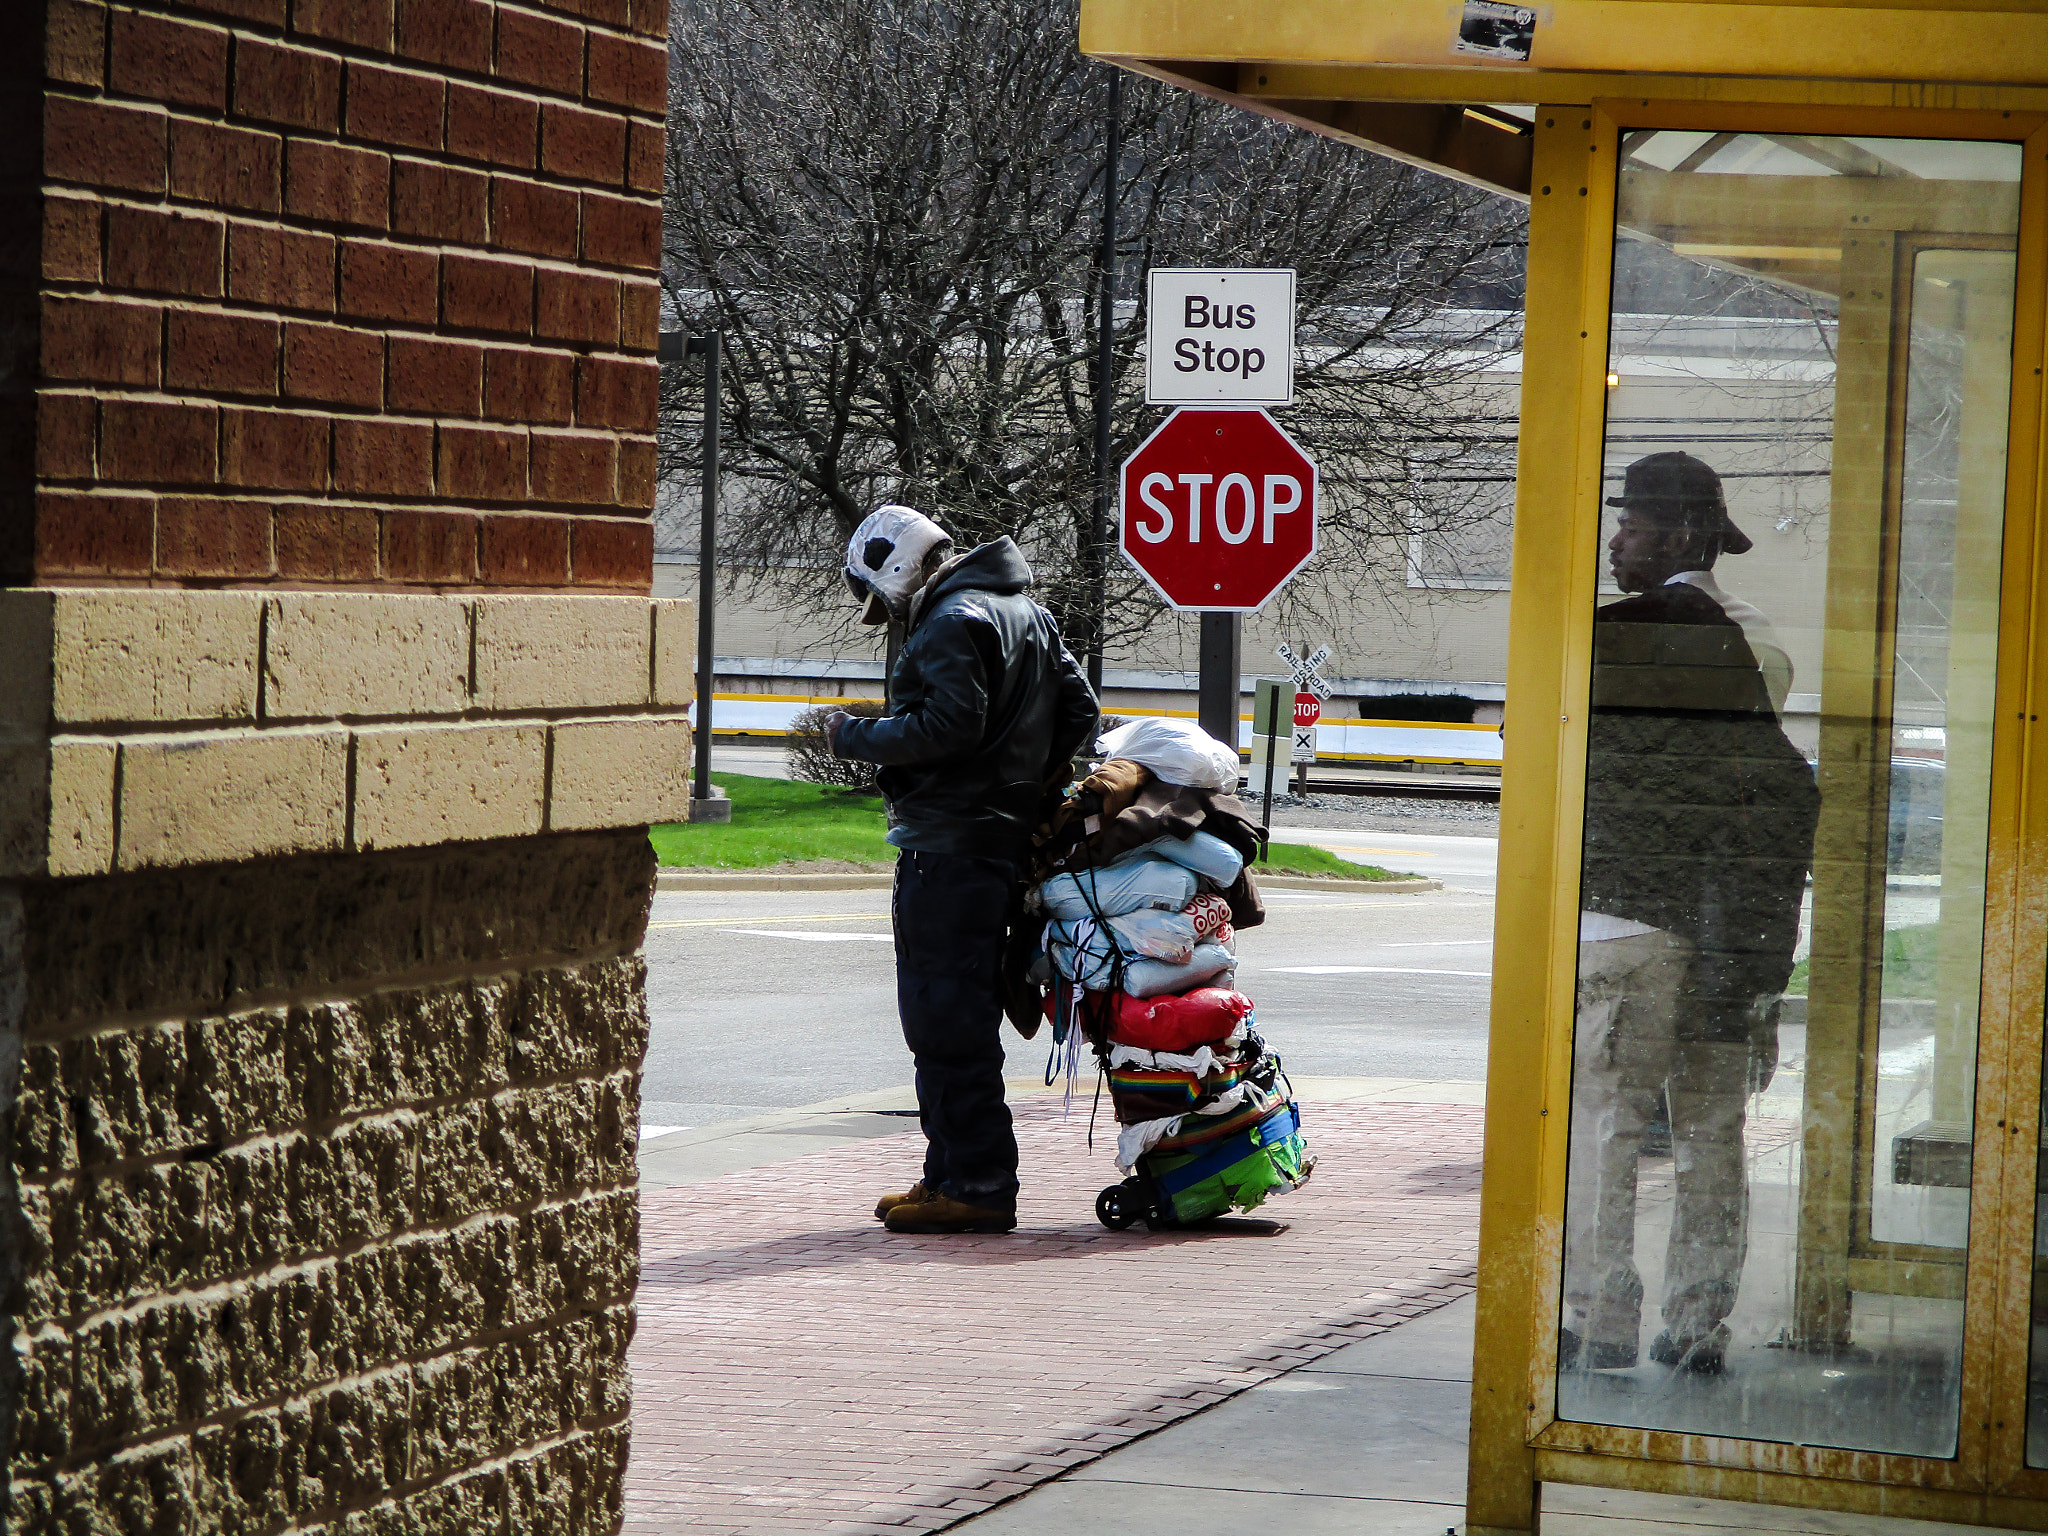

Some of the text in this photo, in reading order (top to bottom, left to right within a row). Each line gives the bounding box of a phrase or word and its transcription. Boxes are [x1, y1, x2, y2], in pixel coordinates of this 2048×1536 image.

[1184, 295, 1256, 329] Bus
[1173, 337, 1266, 380] Stop
[1135, 472, 1303, 545] STOP
